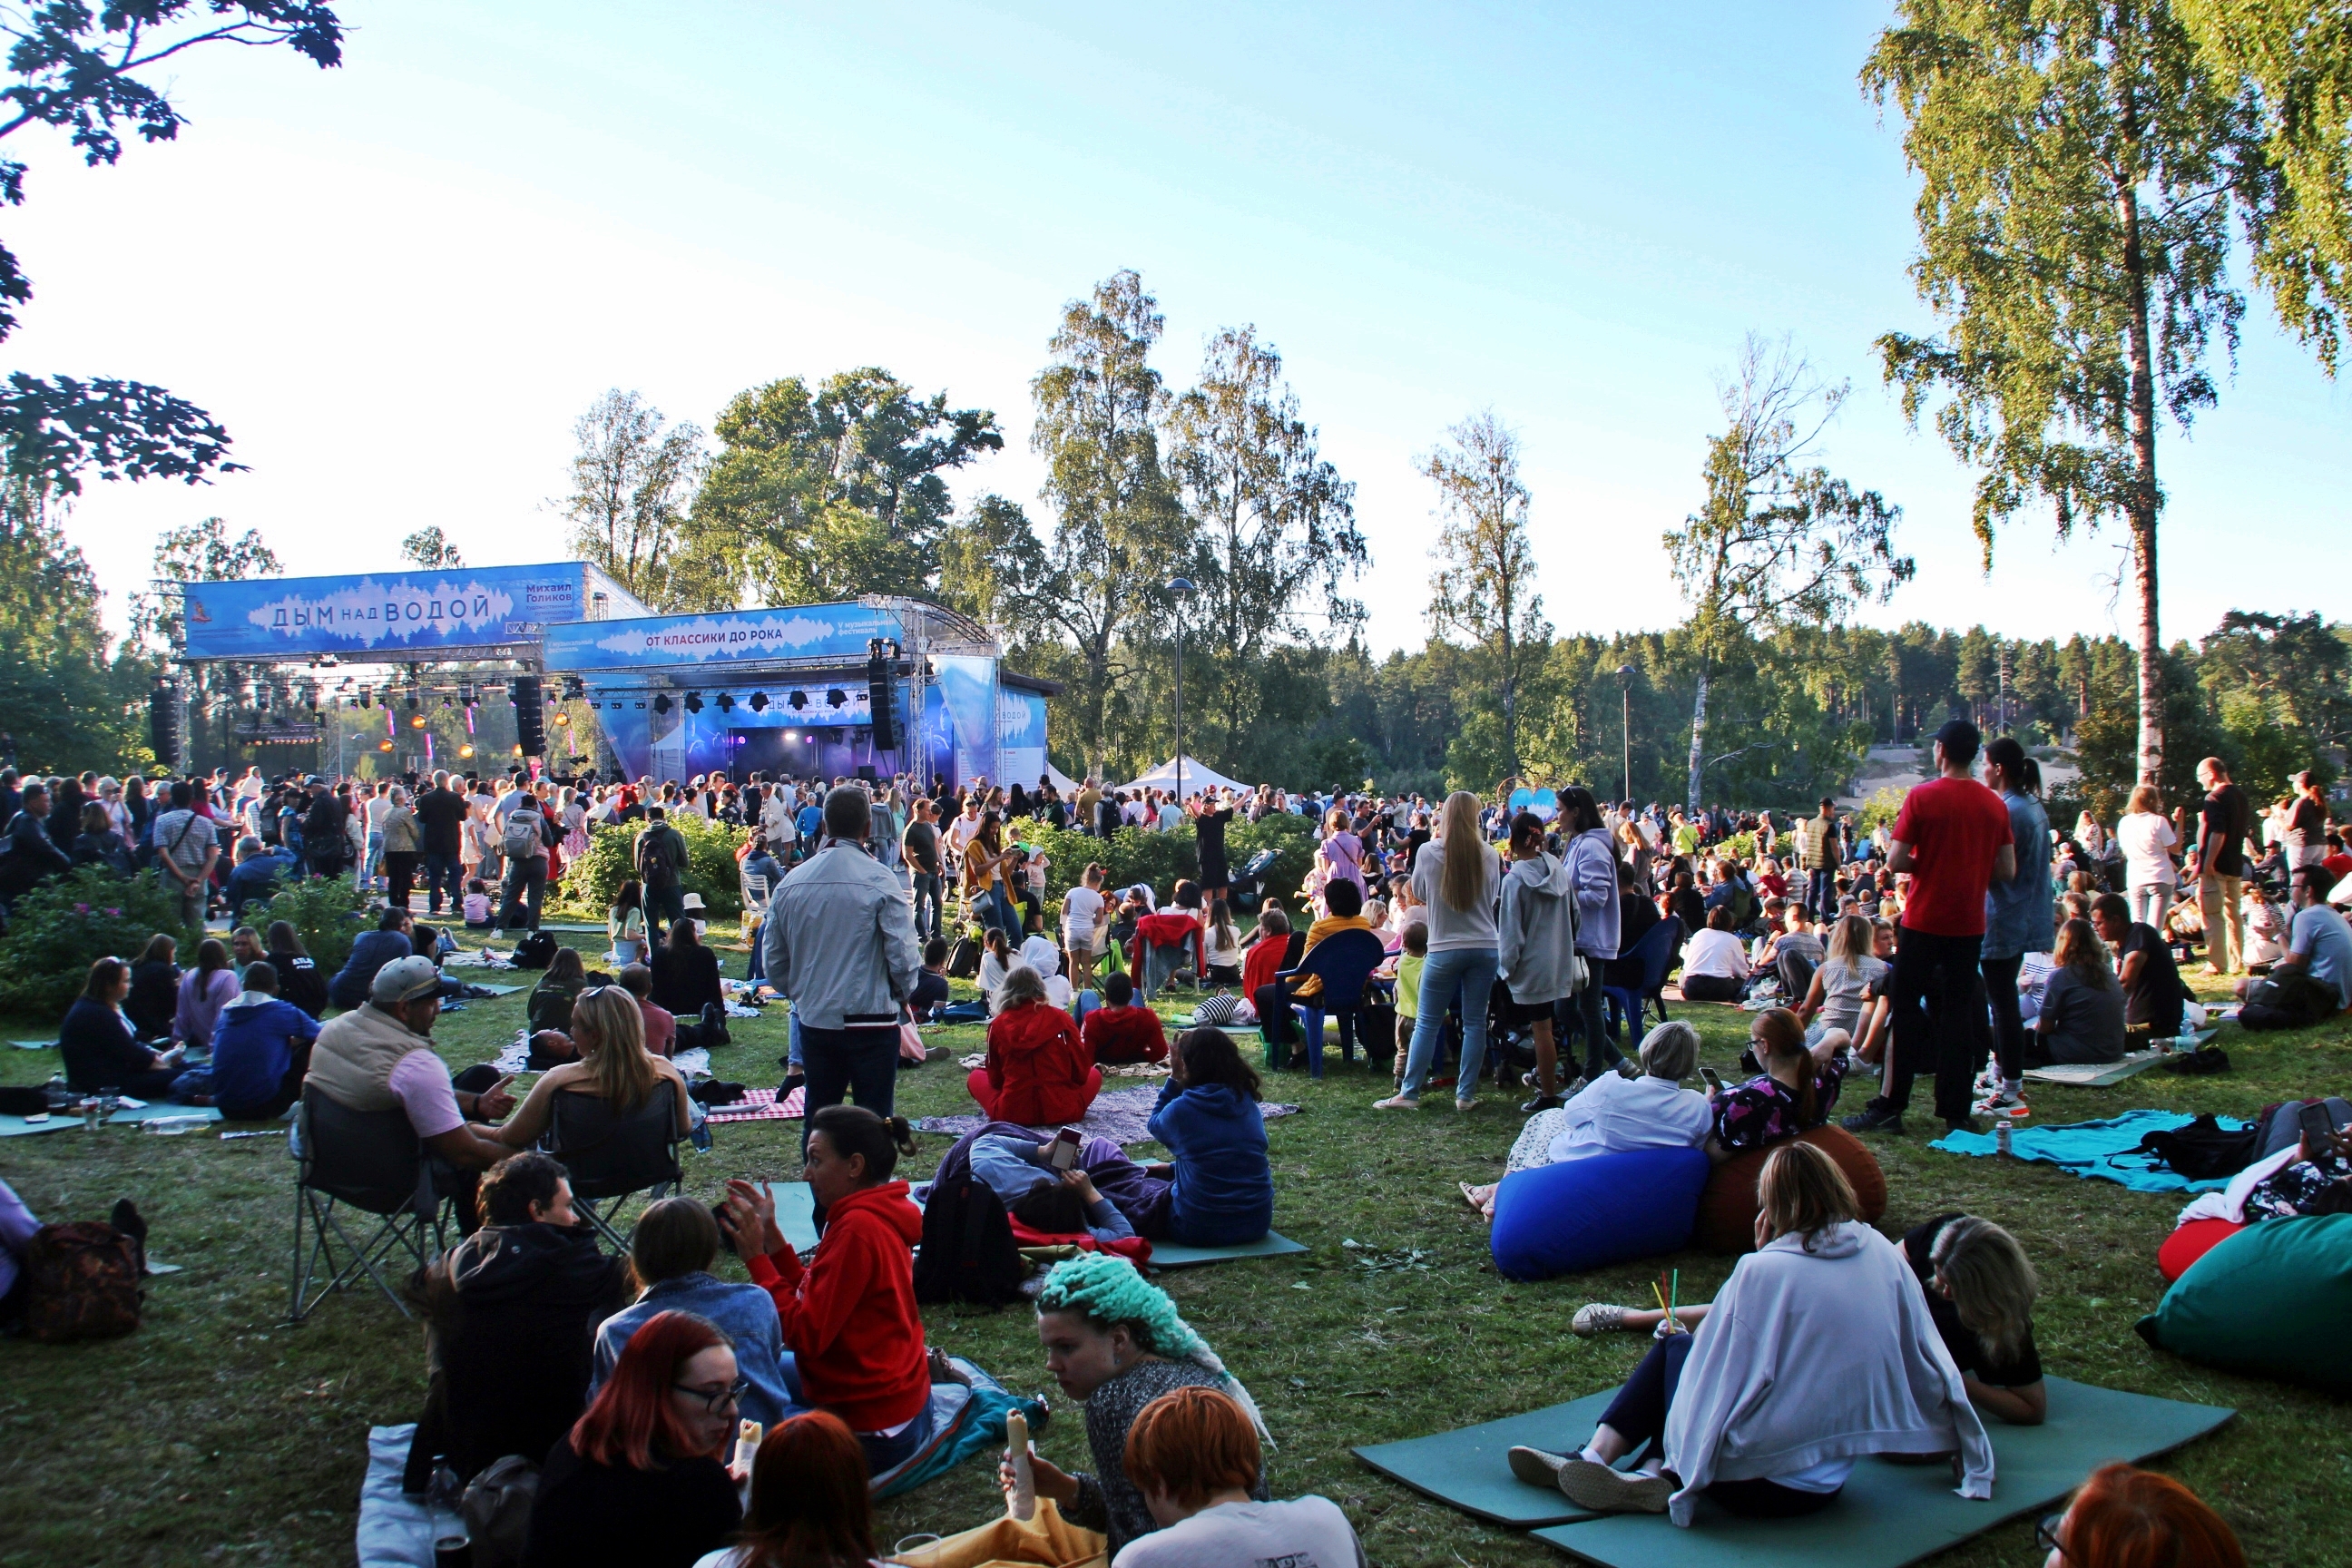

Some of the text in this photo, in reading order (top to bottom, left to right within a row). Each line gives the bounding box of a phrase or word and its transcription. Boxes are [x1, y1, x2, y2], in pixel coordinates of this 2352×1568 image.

[526, 584, 572, 593] Михаил
[526, 593, 573, 603] Голиков
[272, 594, 489, 627] ДЫМ НАД ВОДОЙ
[845, 618, 897, 631] музыкальный
[838, 627, 877, 637] фестиваль
[646, 629, 783, 646] ОТ КЛАССИКИ ДО РОКА
[1002, 710, 1026, 720] ВОДОЙ
